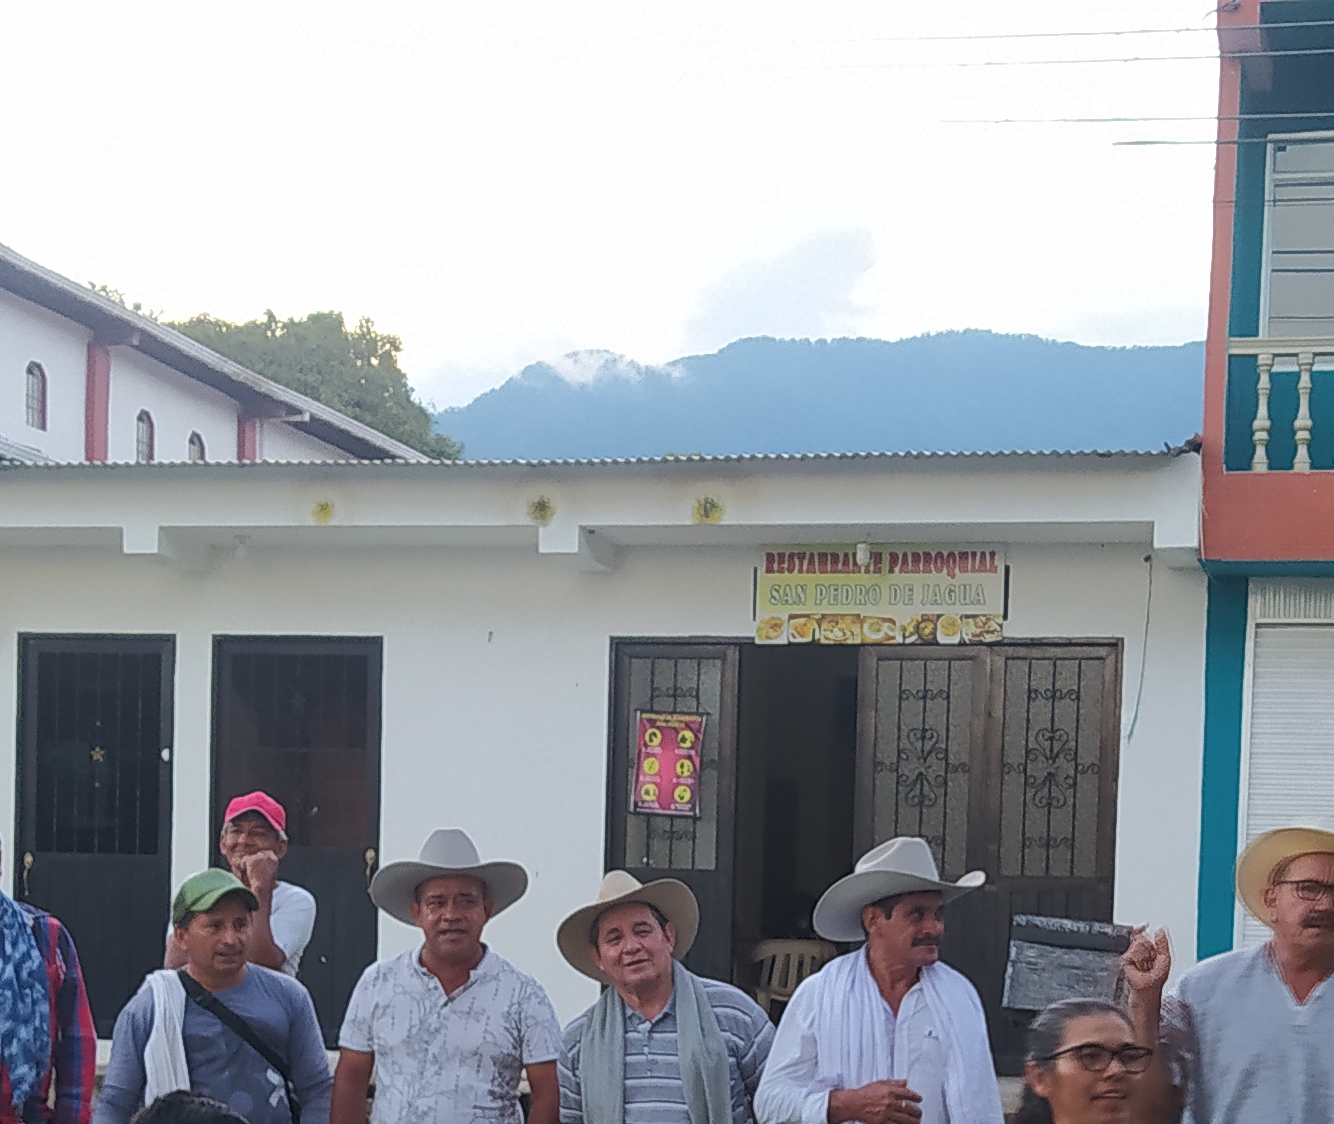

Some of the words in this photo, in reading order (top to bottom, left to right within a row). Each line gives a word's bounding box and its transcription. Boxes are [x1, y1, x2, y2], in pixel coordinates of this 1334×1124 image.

[888, 551, 998, 580] PARROQUIAL
[769, 584, 807, 605] SAN
[815, 584, 882, 605] PEDRO
[889, 584, 914, 605] DE
[921, 584, 986, 605] JAGUA
